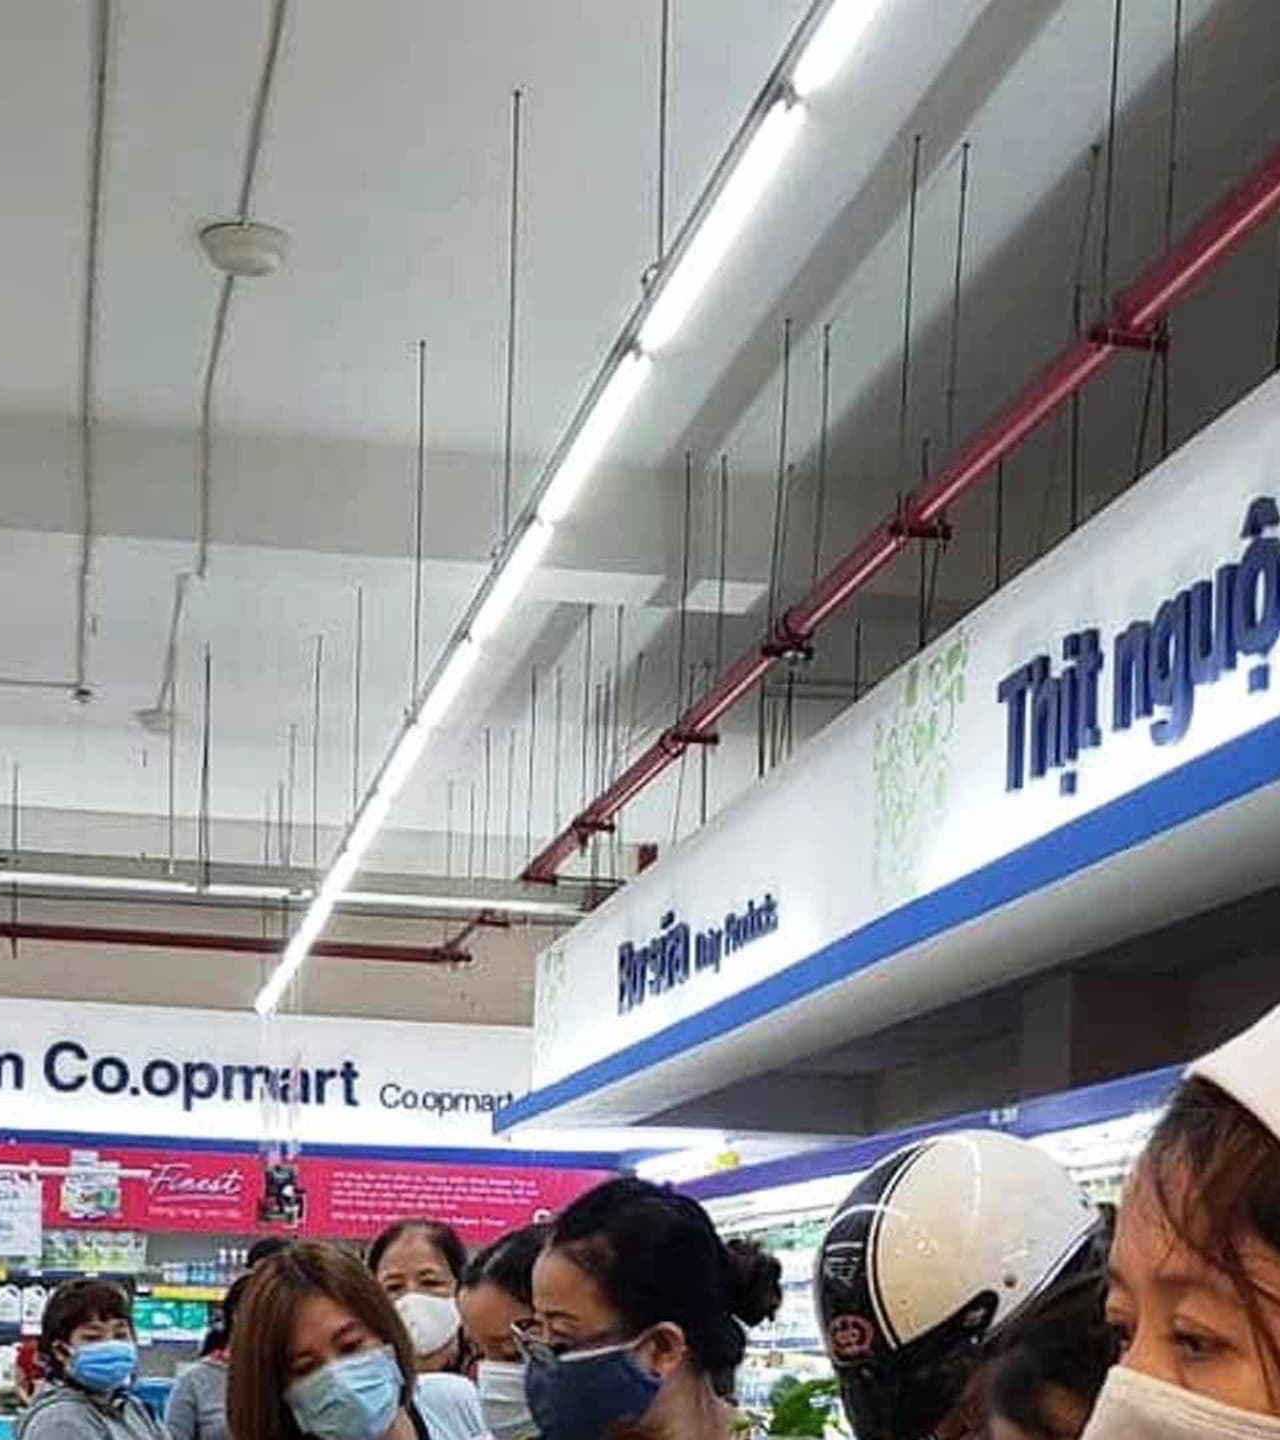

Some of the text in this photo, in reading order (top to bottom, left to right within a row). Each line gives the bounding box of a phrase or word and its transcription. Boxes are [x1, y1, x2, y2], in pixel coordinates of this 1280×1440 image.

[998, 628, 1103, 794] Thịt
[43, 1040, 360, 1112] Co.opmart
[147, 1163, 245, 1195] Finest
